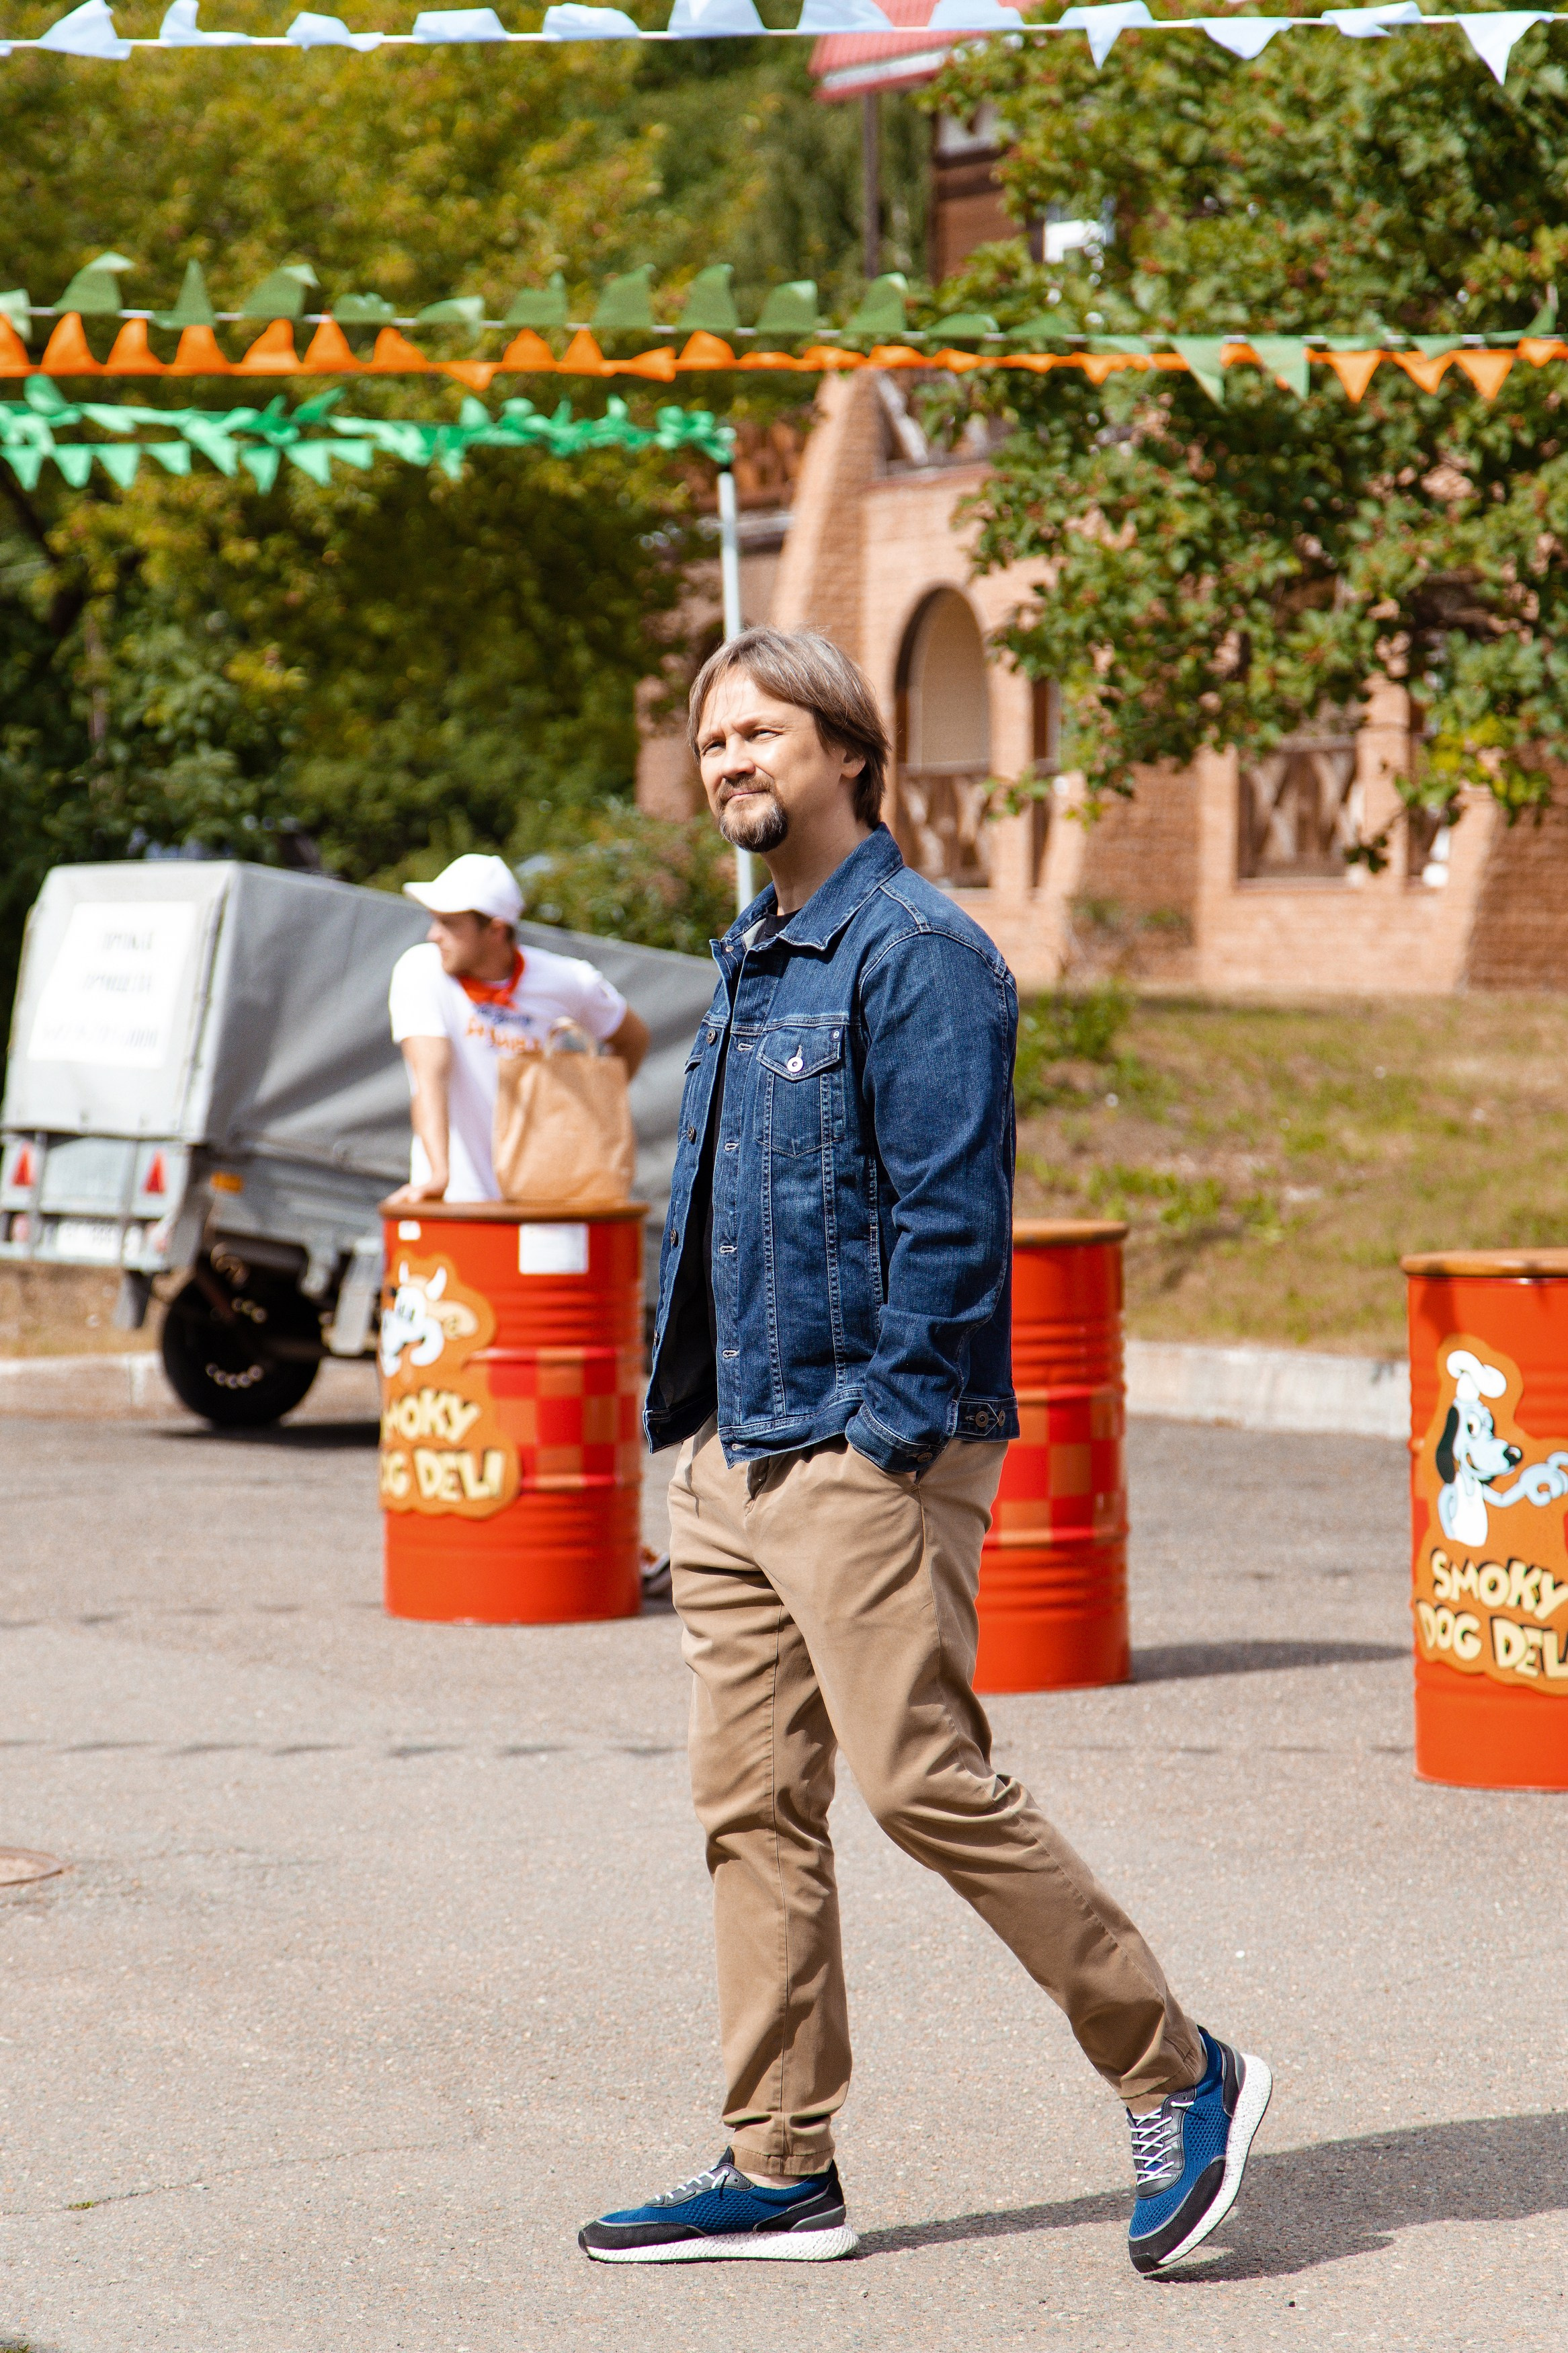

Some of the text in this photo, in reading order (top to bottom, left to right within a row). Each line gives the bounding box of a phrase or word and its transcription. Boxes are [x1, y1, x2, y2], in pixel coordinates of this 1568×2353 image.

[380, 1386, 481, 1444] MOKY
[413, 1447, 503, 1501] DELI
[1430, 1548, 1568, 1621] SMOKY
[1416, 1599, 1568, 1679] DOG DEL
